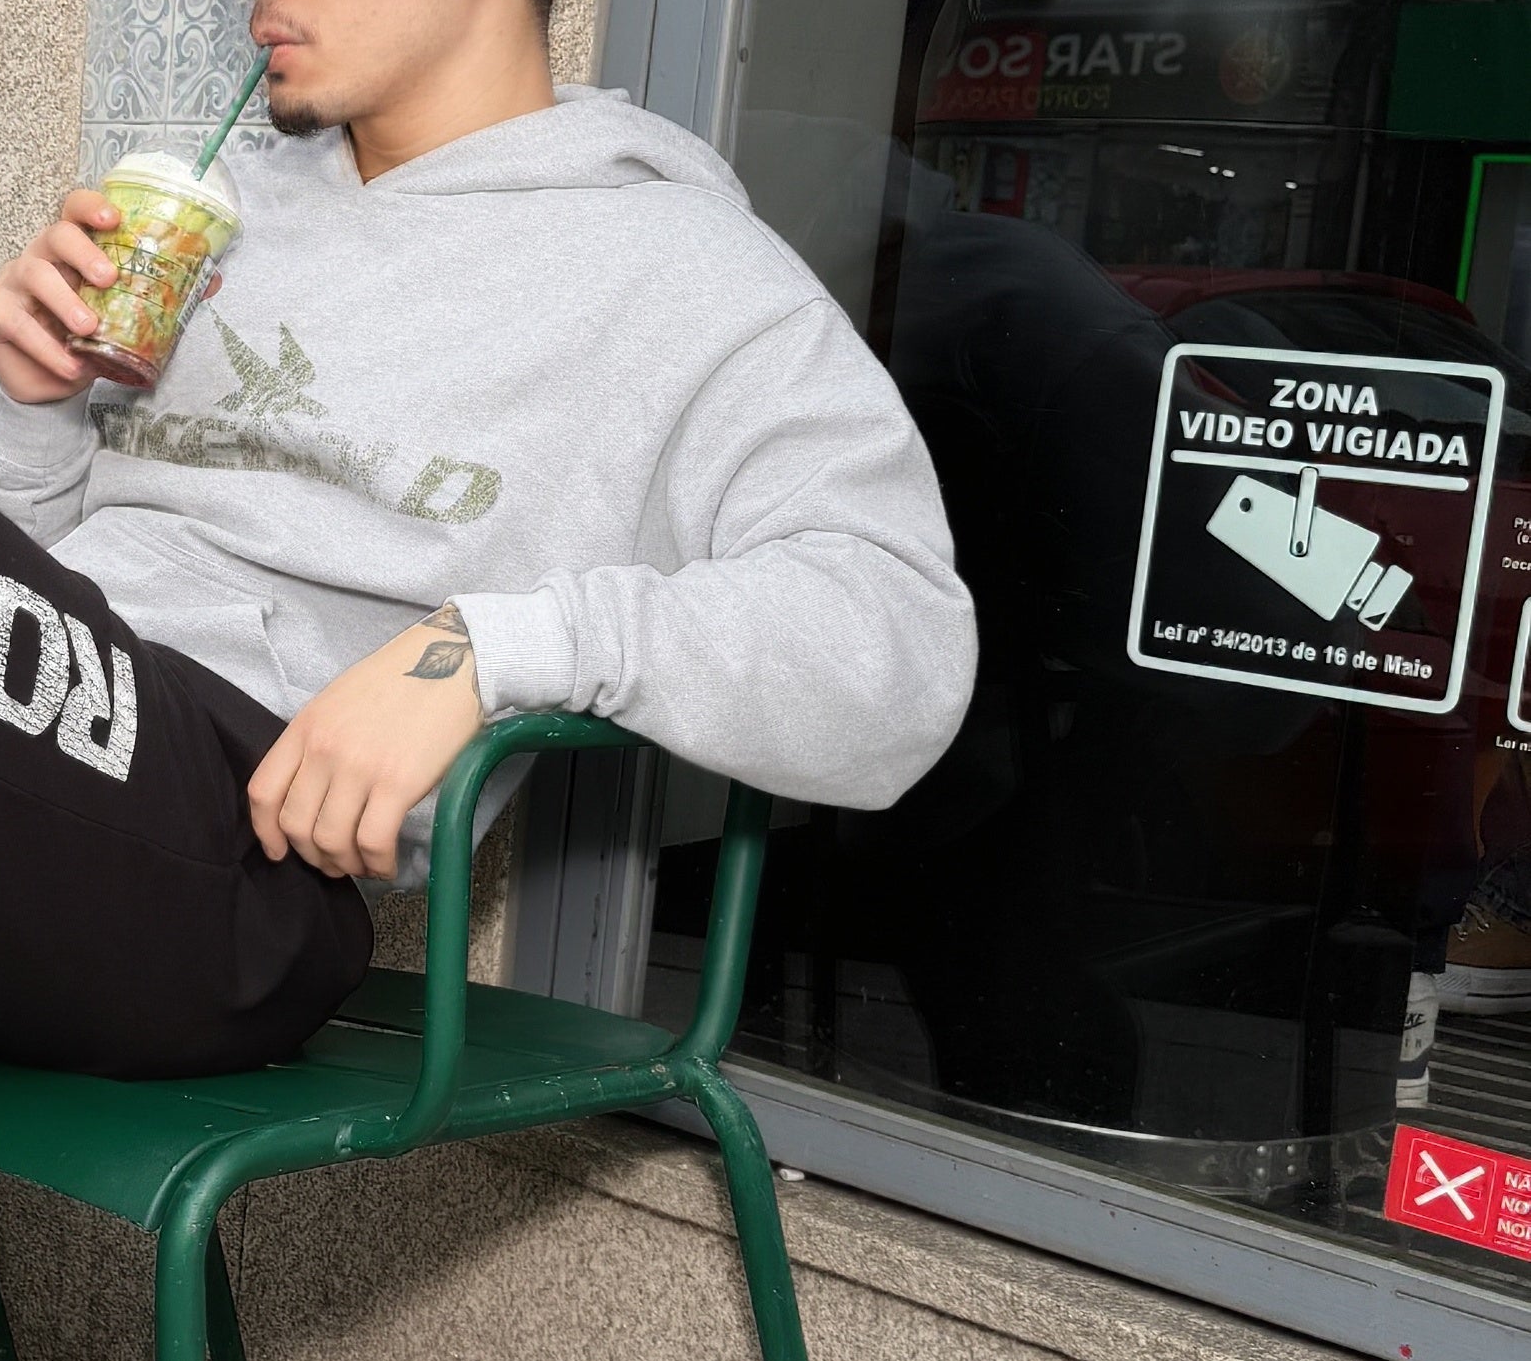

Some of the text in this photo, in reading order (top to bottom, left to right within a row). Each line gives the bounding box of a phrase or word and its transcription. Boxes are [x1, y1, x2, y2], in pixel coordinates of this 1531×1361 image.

[1269, 378, 1379, 416] ZONA
[1179, 410, 1470, 467] VIDEO VIGIADA
[1153, 620, 1433, 680] Lei nº 34/2013 de 16 de Maio
